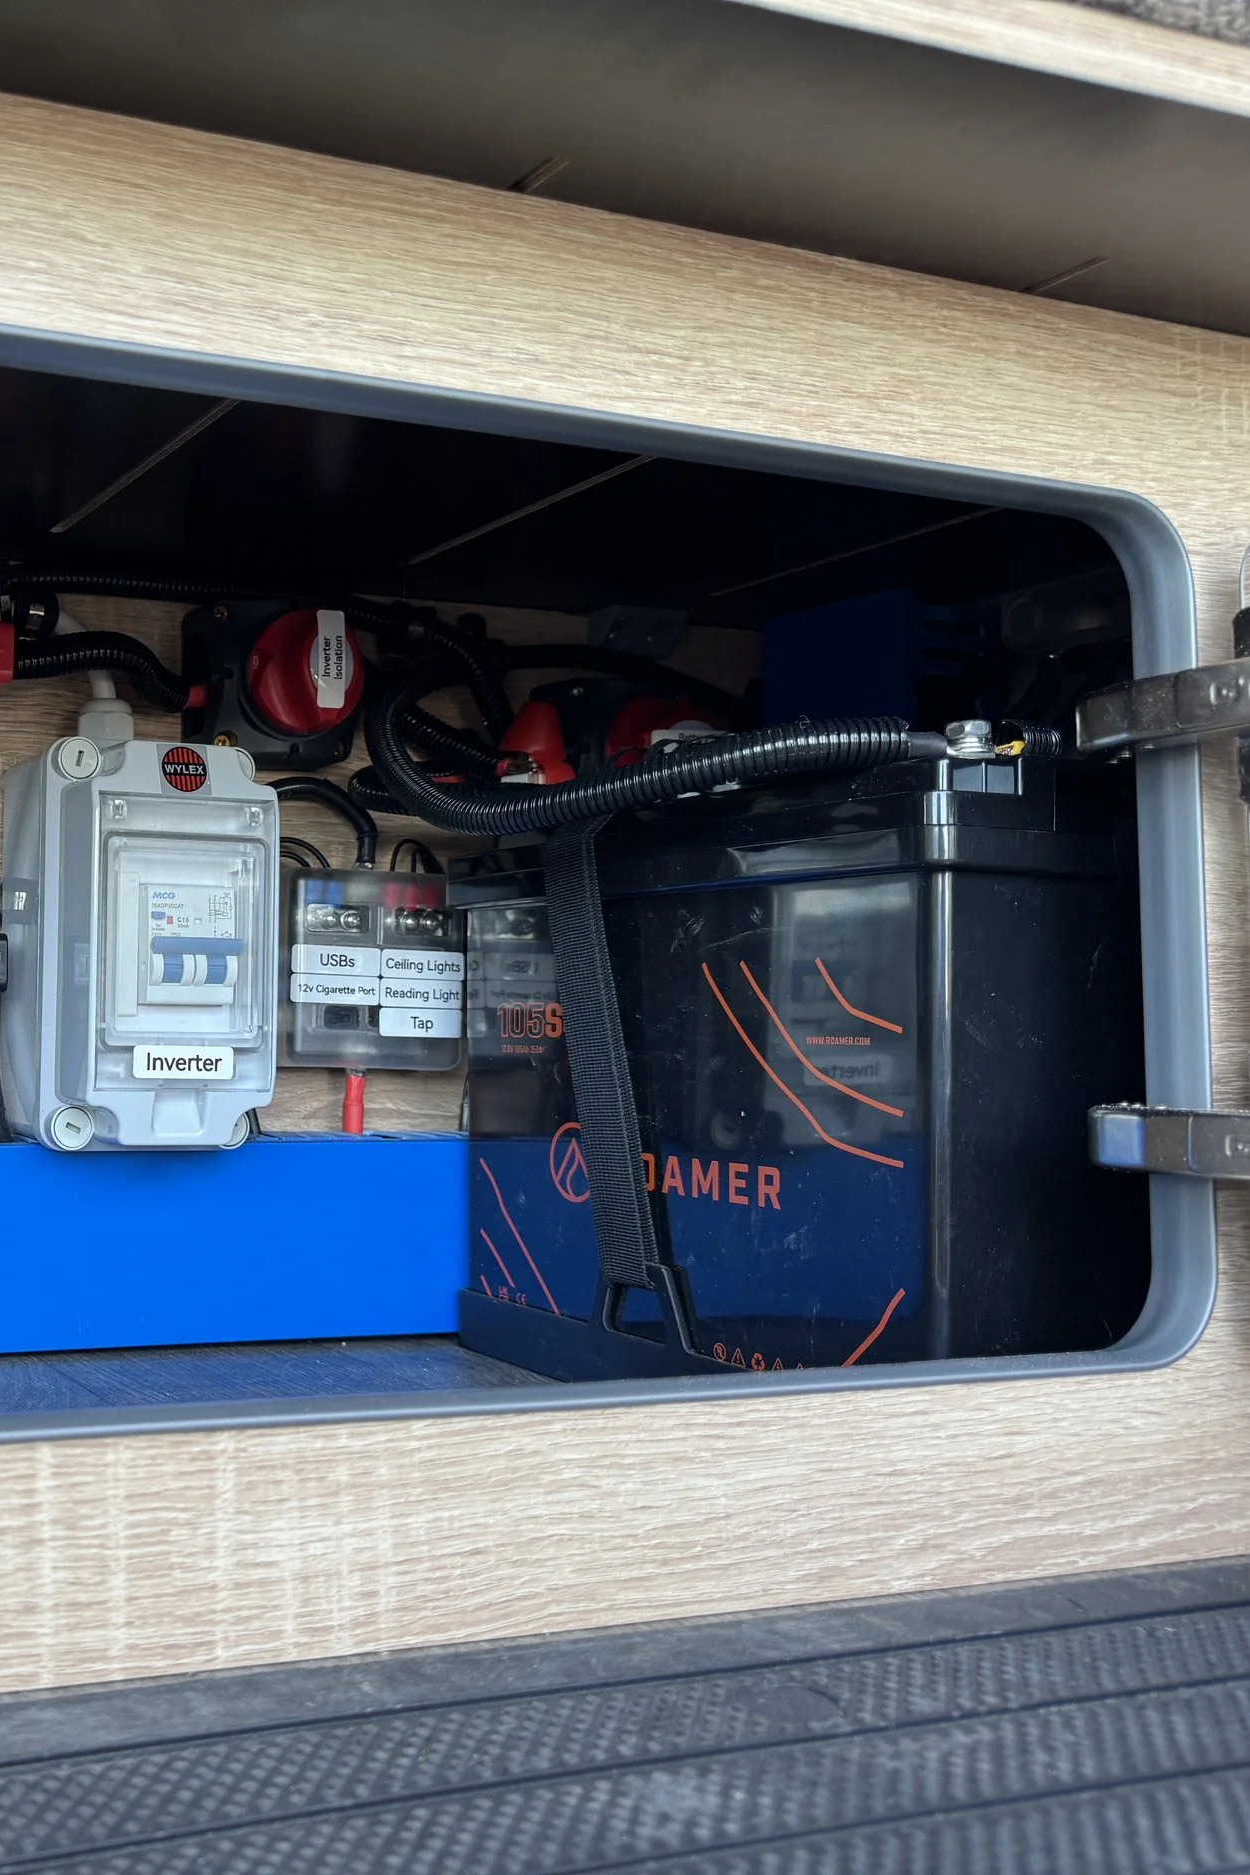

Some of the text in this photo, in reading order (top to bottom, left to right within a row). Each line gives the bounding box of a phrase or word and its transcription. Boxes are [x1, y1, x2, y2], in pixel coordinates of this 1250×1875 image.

[321, 636, 331, 678] Inverter
[333, 635, 343, 680] Isolation
[164, 764, 205, 775] WYLEX
[152, 892, 176, 900] MCG
[320, 953, 356, 967] USBs
[385, 958, 461, 974] Ceiling Lights
[298, 984, 376, 997] 12v Cigarette Port
[385, 987, 461, 1002] Reading Light
[410, 1016, 434, 1032] Tap
[806, 1036, 871, 1046] WWW.ROAMER.COM
[146, 1052, 223, 1072] Inverter
